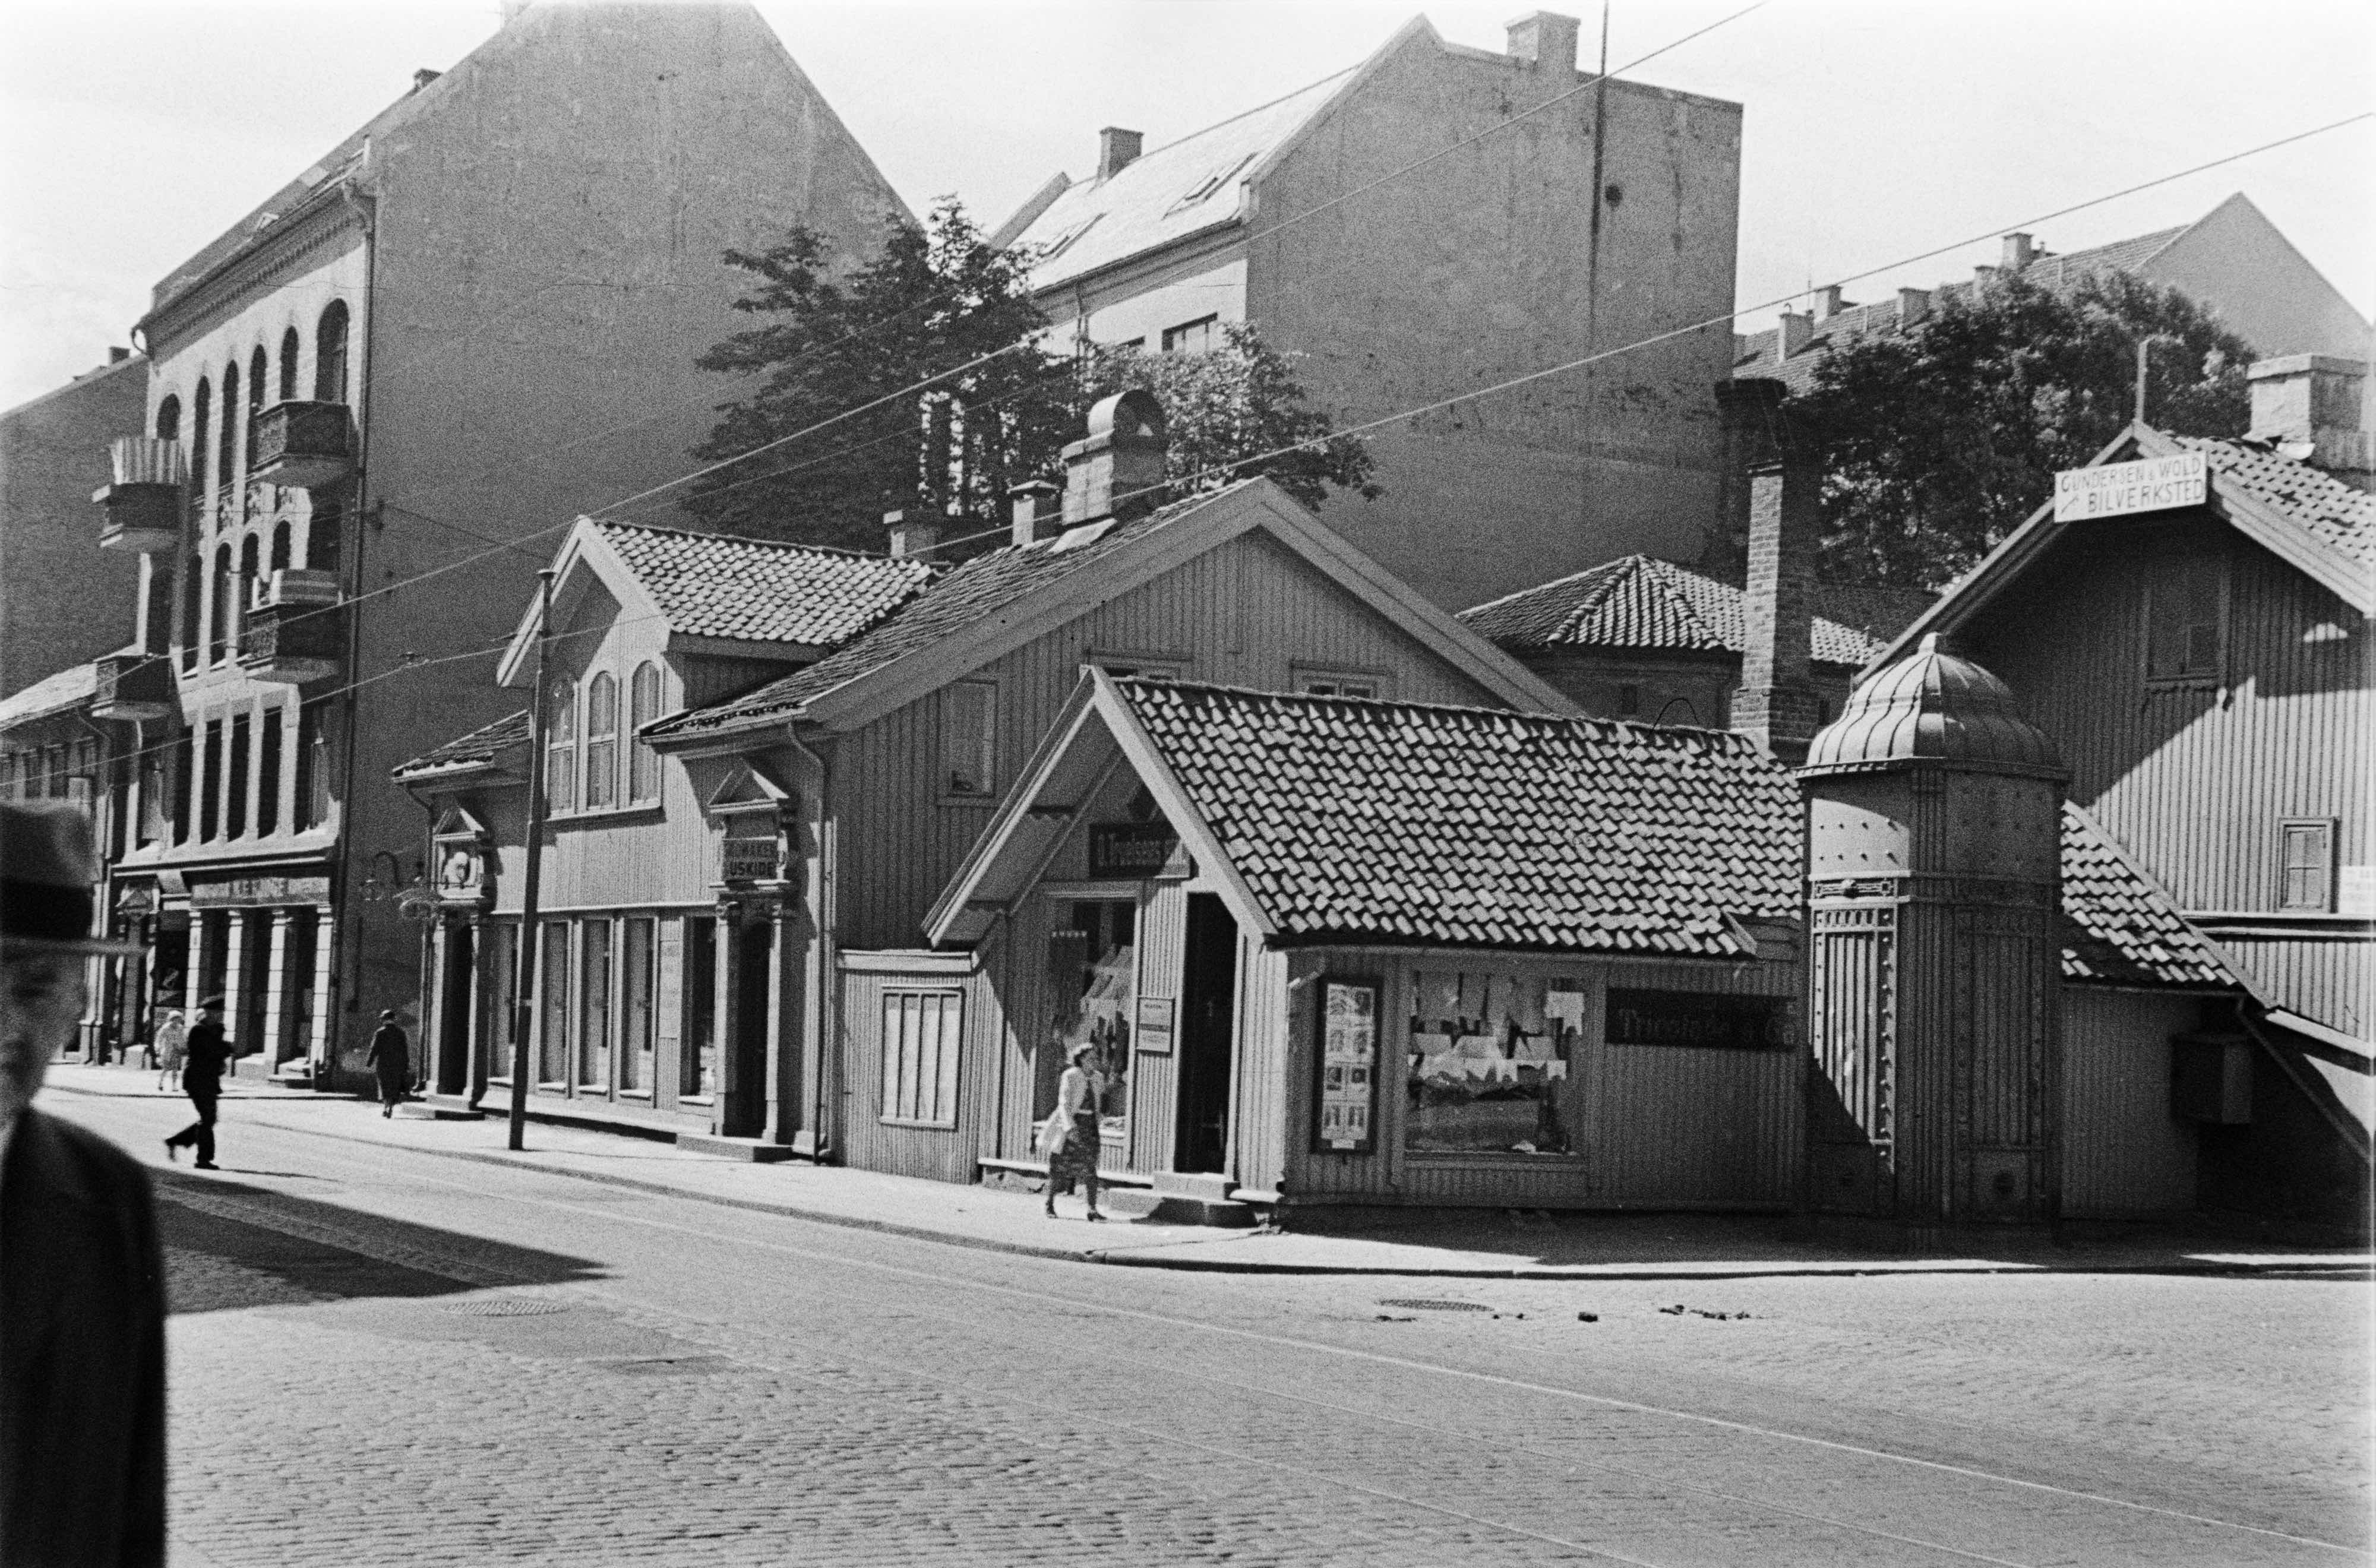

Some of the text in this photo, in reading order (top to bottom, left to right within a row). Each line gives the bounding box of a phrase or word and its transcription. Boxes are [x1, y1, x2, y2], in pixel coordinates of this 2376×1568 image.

[2061, 465, 2145, 492] GUNDERSEN
[2158, 457, 2201, 478] WOLD
[2087, 478, 2206, 514] BILVERKSTED
